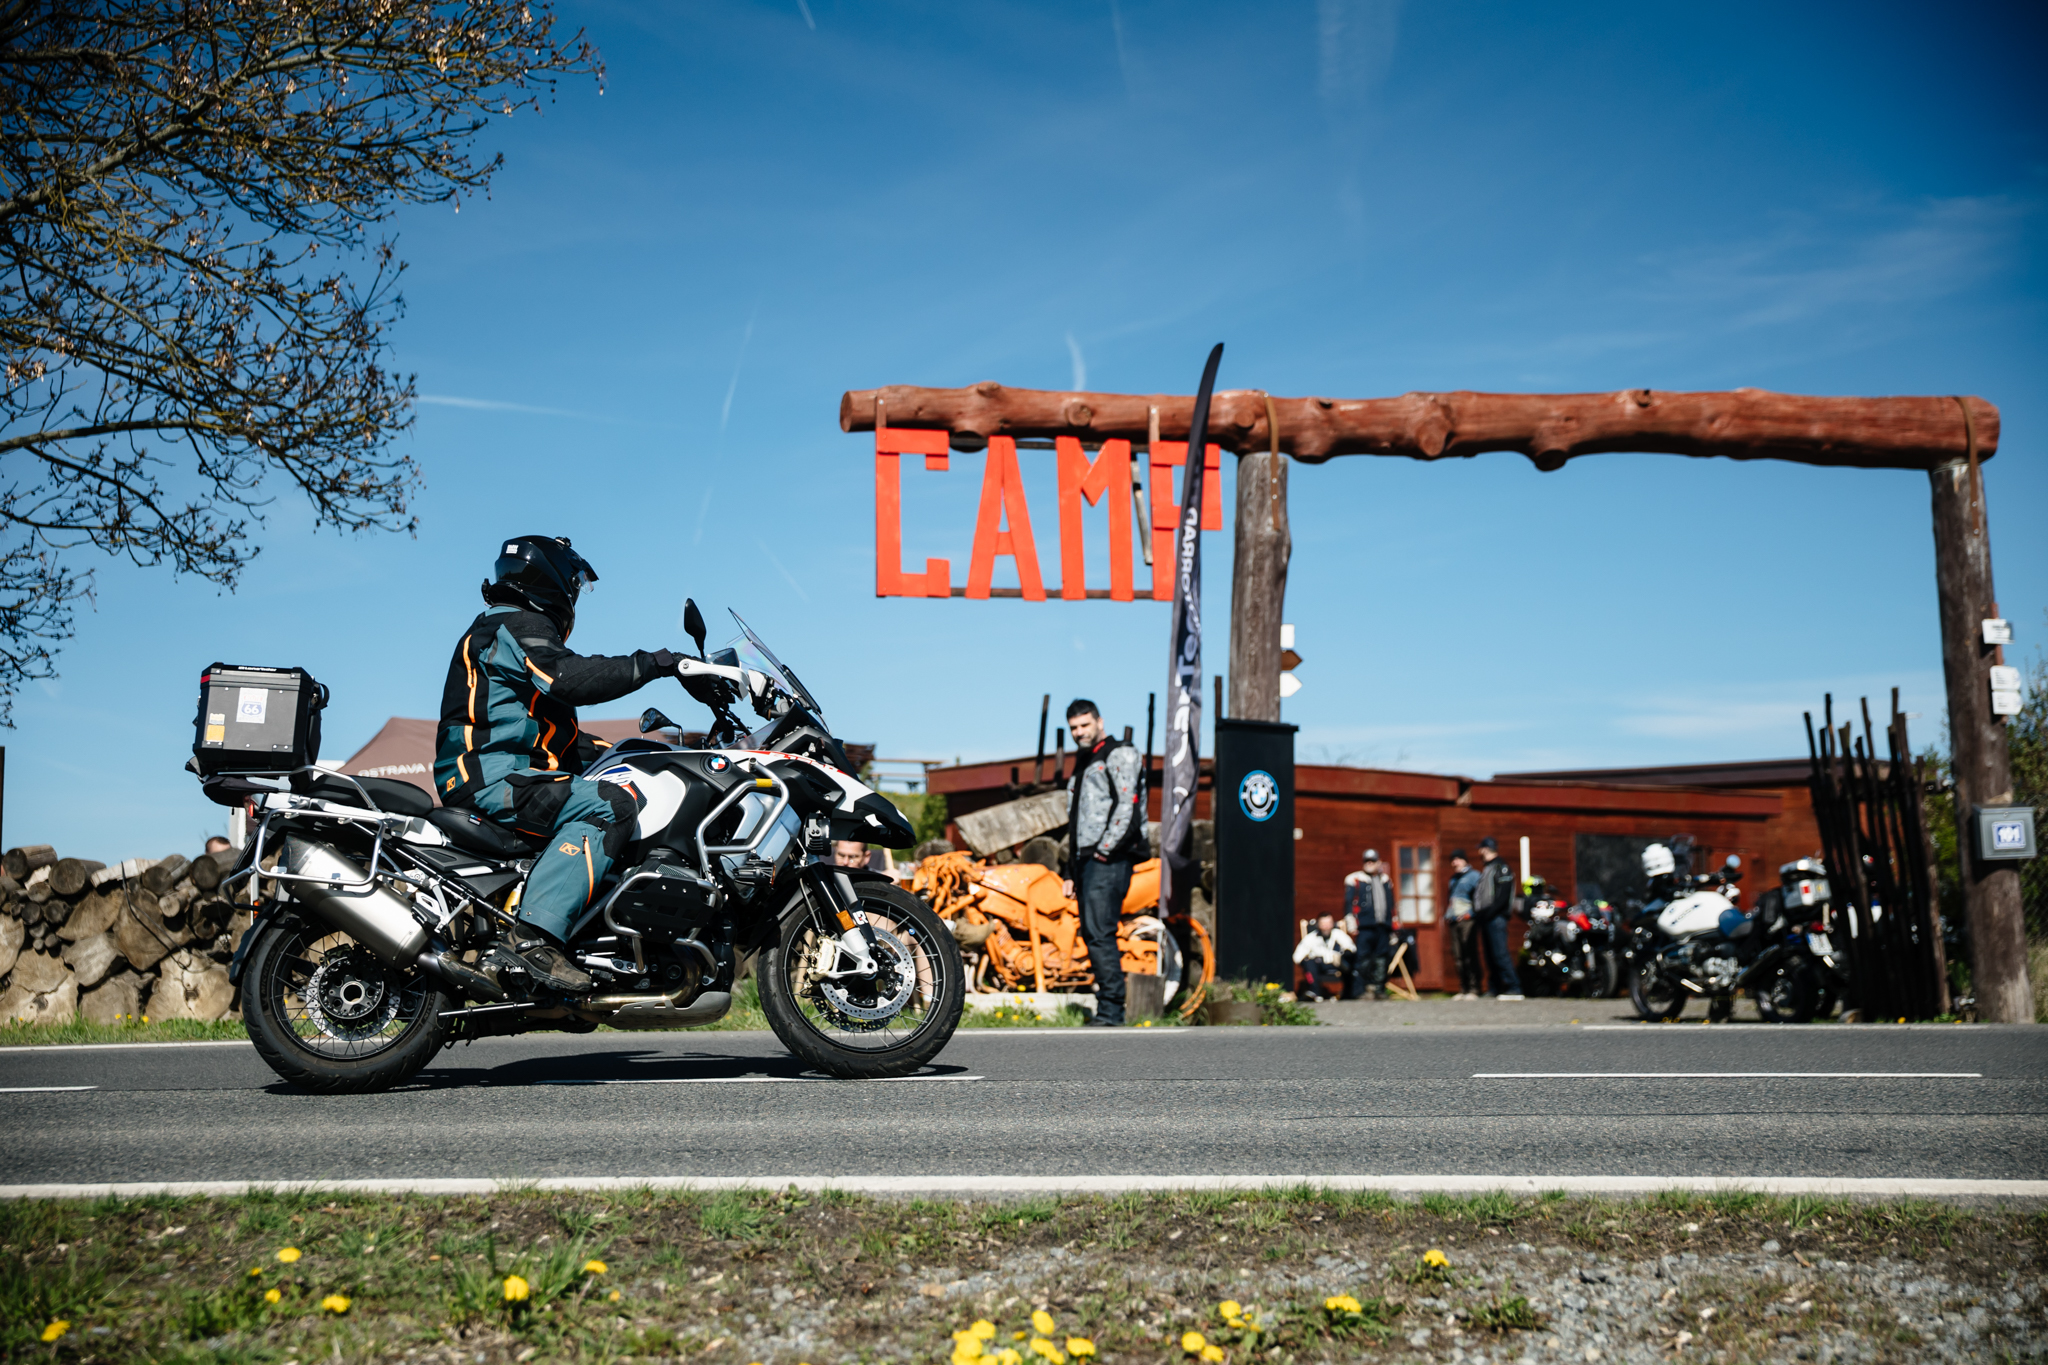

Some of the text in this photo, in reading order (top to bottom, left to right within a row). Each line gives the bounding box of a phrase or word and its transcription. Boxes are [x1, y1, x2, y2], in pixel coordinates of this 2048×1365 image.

[876, 427, 1222, 601] CAMP
[244, 704, 260, 715] 66
[358, 763, 426, 777] OSTRAVA
